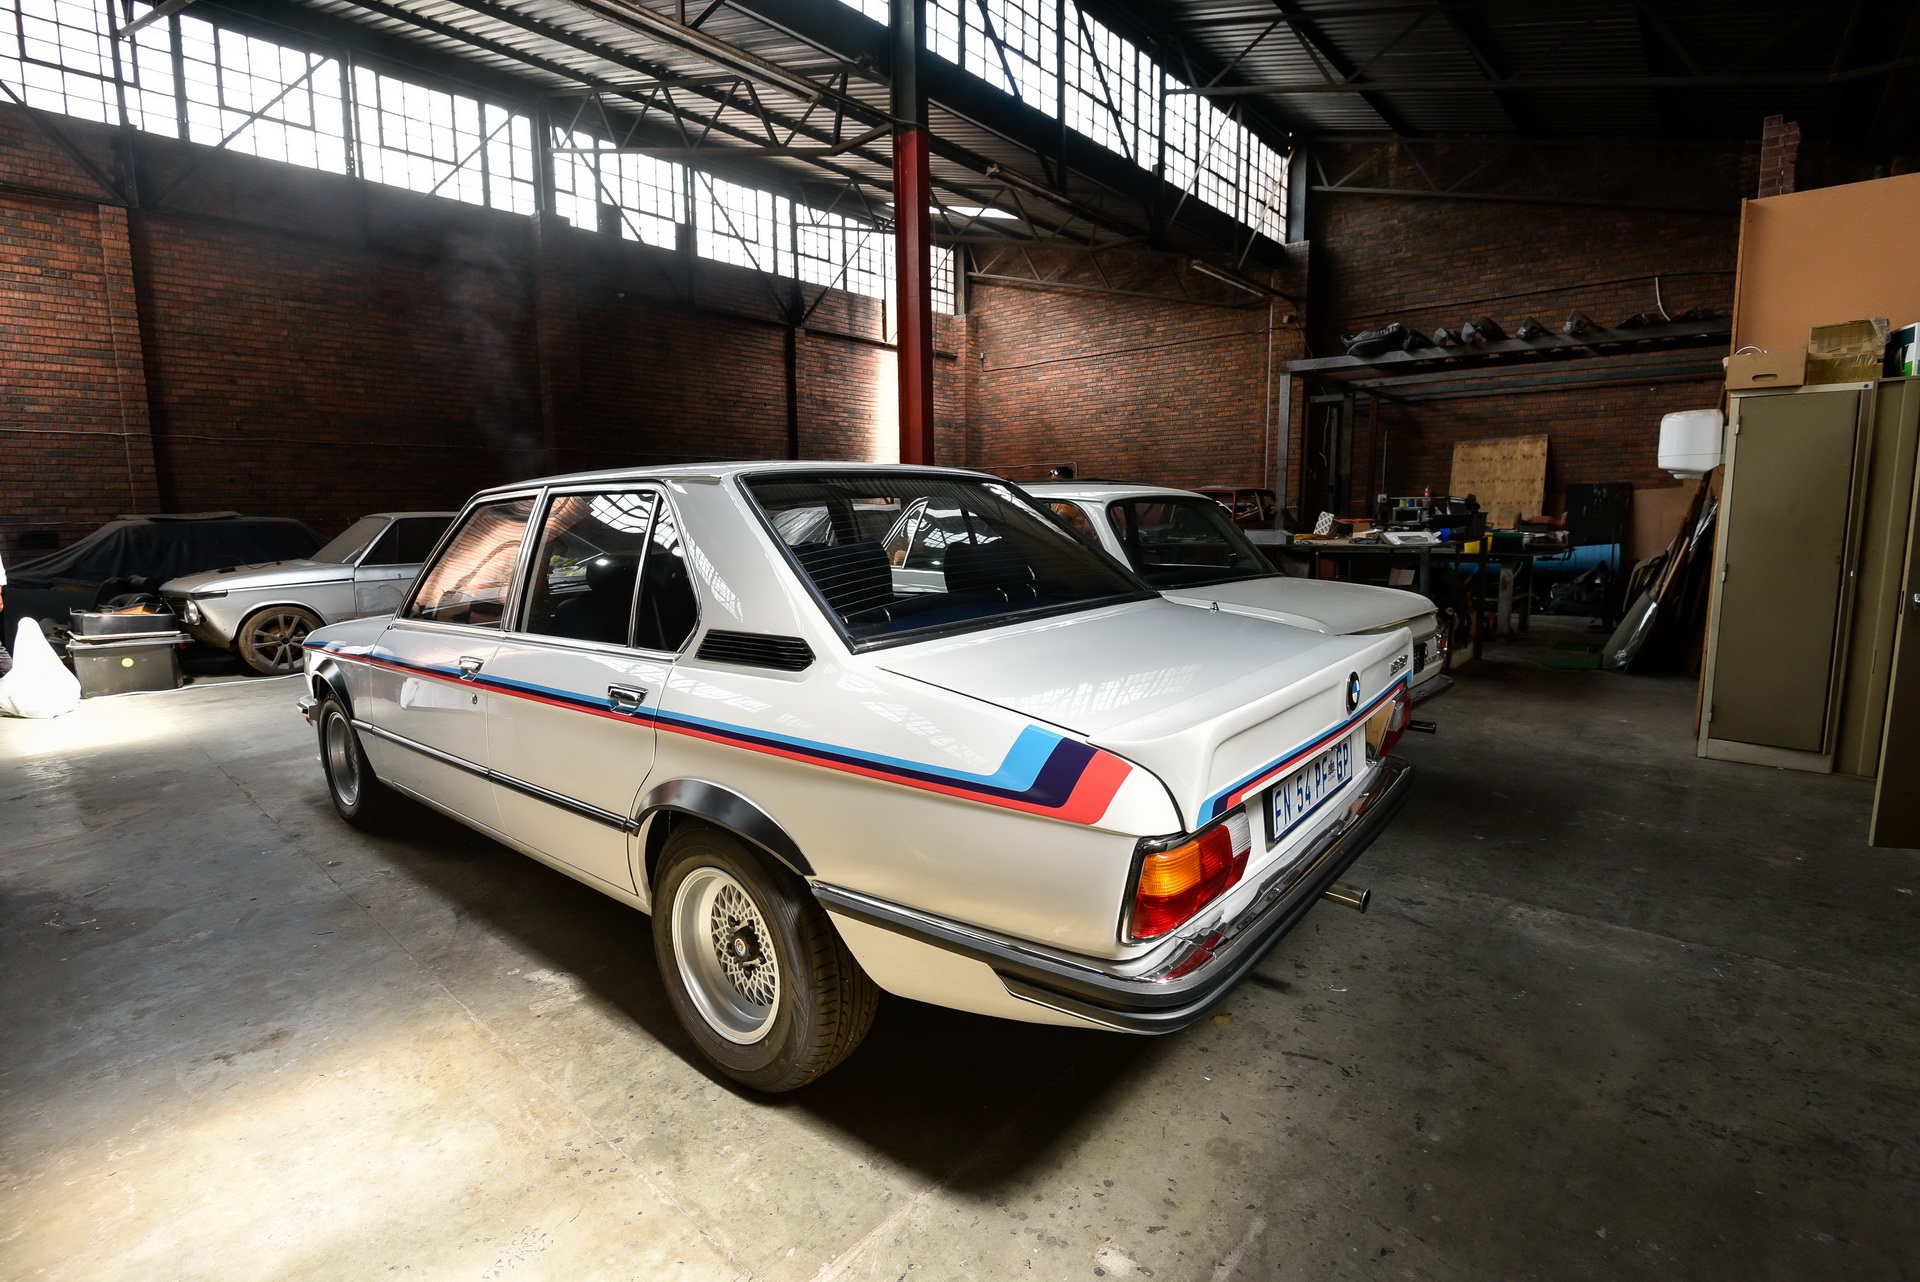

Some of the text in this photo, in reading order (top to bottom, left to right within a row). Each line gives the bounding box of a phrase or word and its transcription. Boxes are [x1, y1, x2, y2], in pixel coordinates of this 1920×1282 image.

[1274, 783, 1291, 833] FN
[1296, 768, 1311, 813] 54
[1314, 756, 1328, 799] PF
